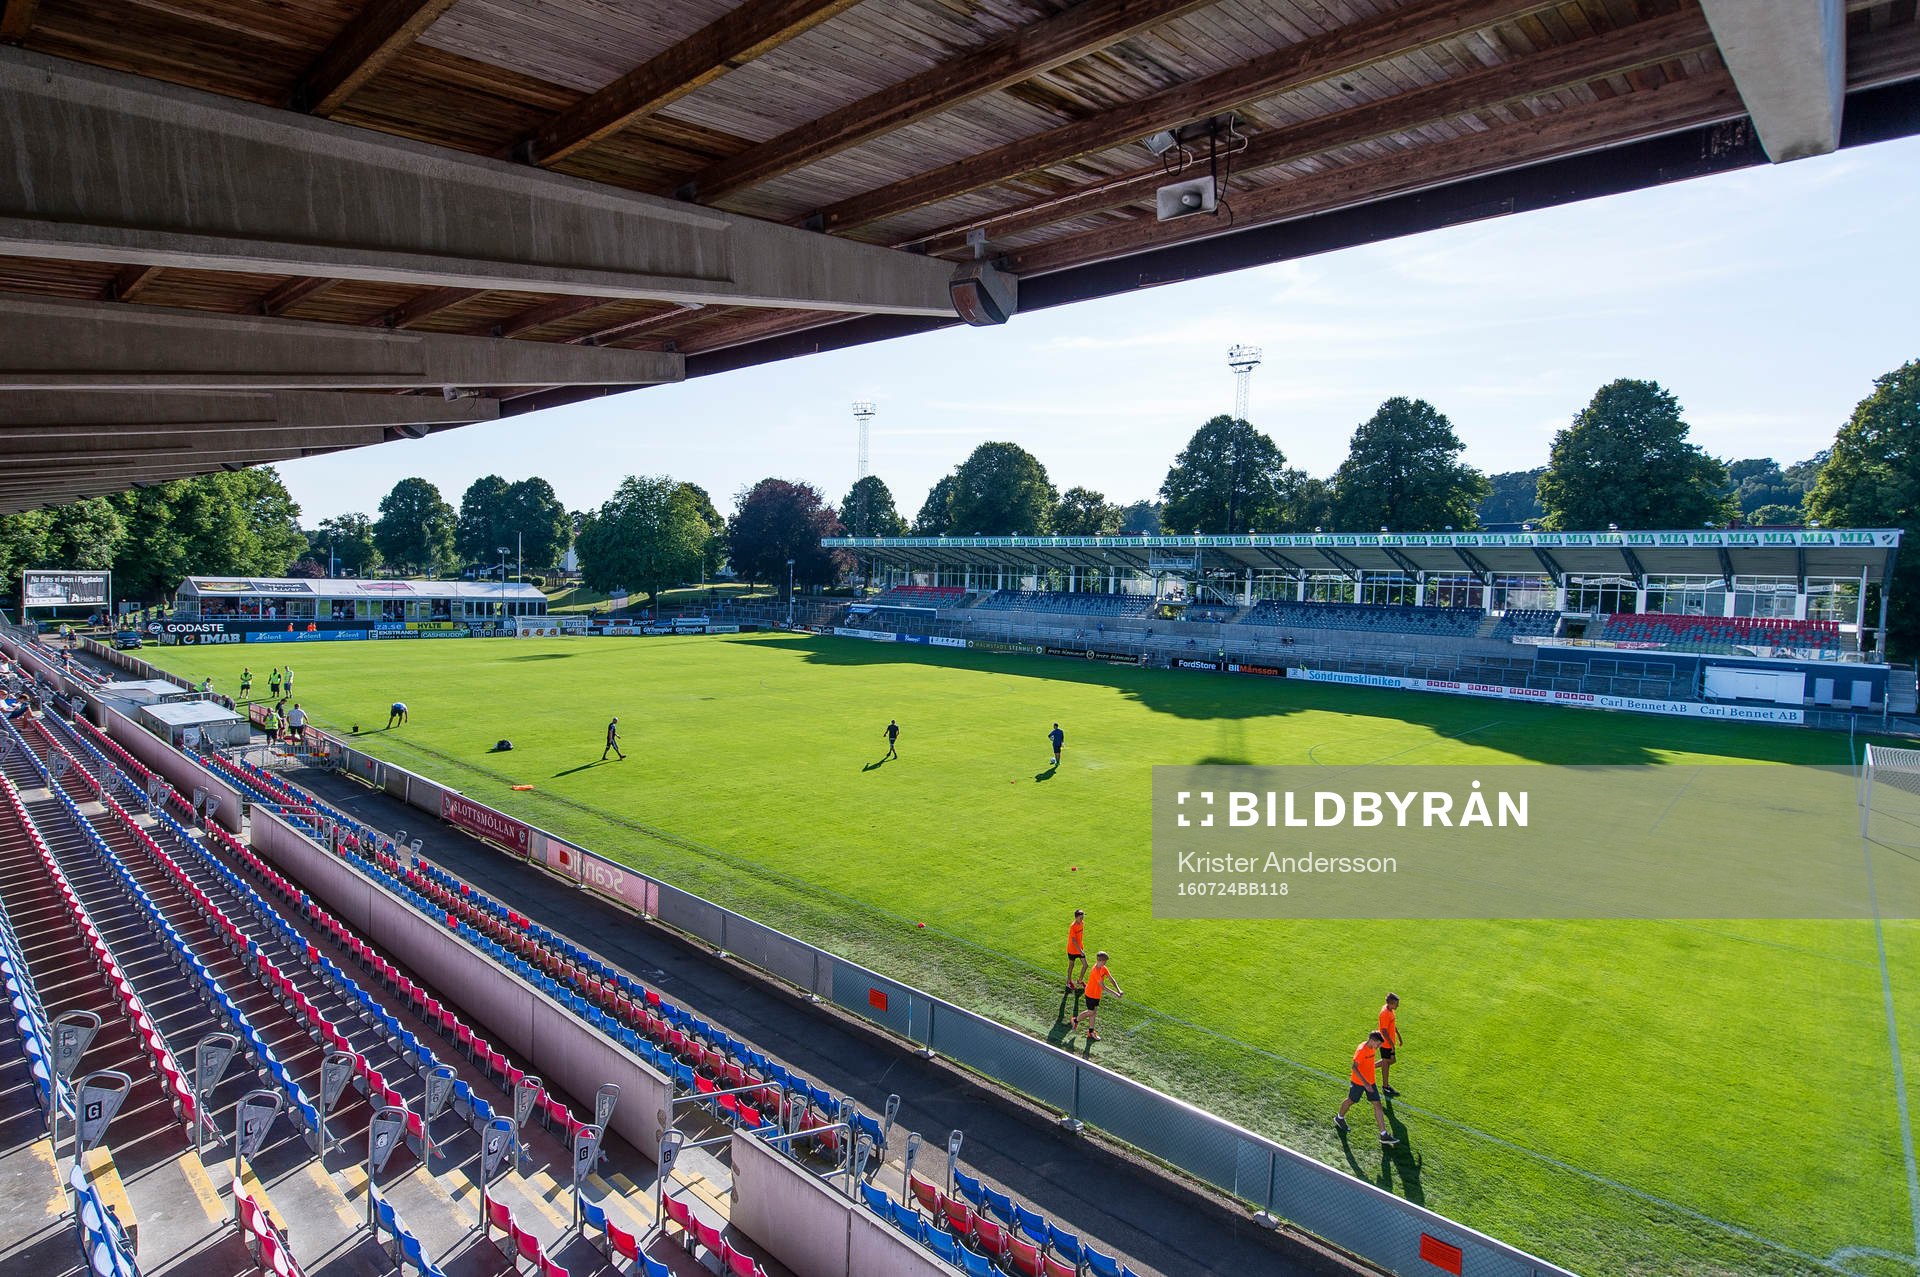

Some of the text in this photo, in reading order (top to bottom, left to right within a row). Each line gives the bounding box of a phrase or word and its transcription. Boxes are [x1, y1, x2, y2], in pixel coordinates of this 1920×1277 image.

[1627, 534, 1652, 542] MTA
[1659, 534, 1685, 542] MTA
[1693, 534, 1720, 542] MTA
[1727, 534, 1756, 542] MTA
[1763, 534, 1793, 542] MTA
[1800, 533, 1832, 542] MTA
[1839, 533, 1872, 542] MTA
[168, 624, 224, 632] GODASTE
[200, 633, 240, 644] IMAB
[1179, 660, 1216, 670] FordStore
[1308, 670, 1400, 687] Söndrumskliniken
[1600, 697, 1622, 707] Carl
[1628, 700, 1666, 712] Bennet
[1671, 704, 1687, 713] AB
[1700, 705, 1797, 720] Carl Bennet AB
[454, 801, 514, 838] SLOTTSMÖLLAN
[63, 1048, 72, 1057] 9
[206, 1052, 216, 1066] F
[88, 1105, 99, 1119] G
[581, 1148, 587, 1158] G
[665, 1152, 670, 1160] G
